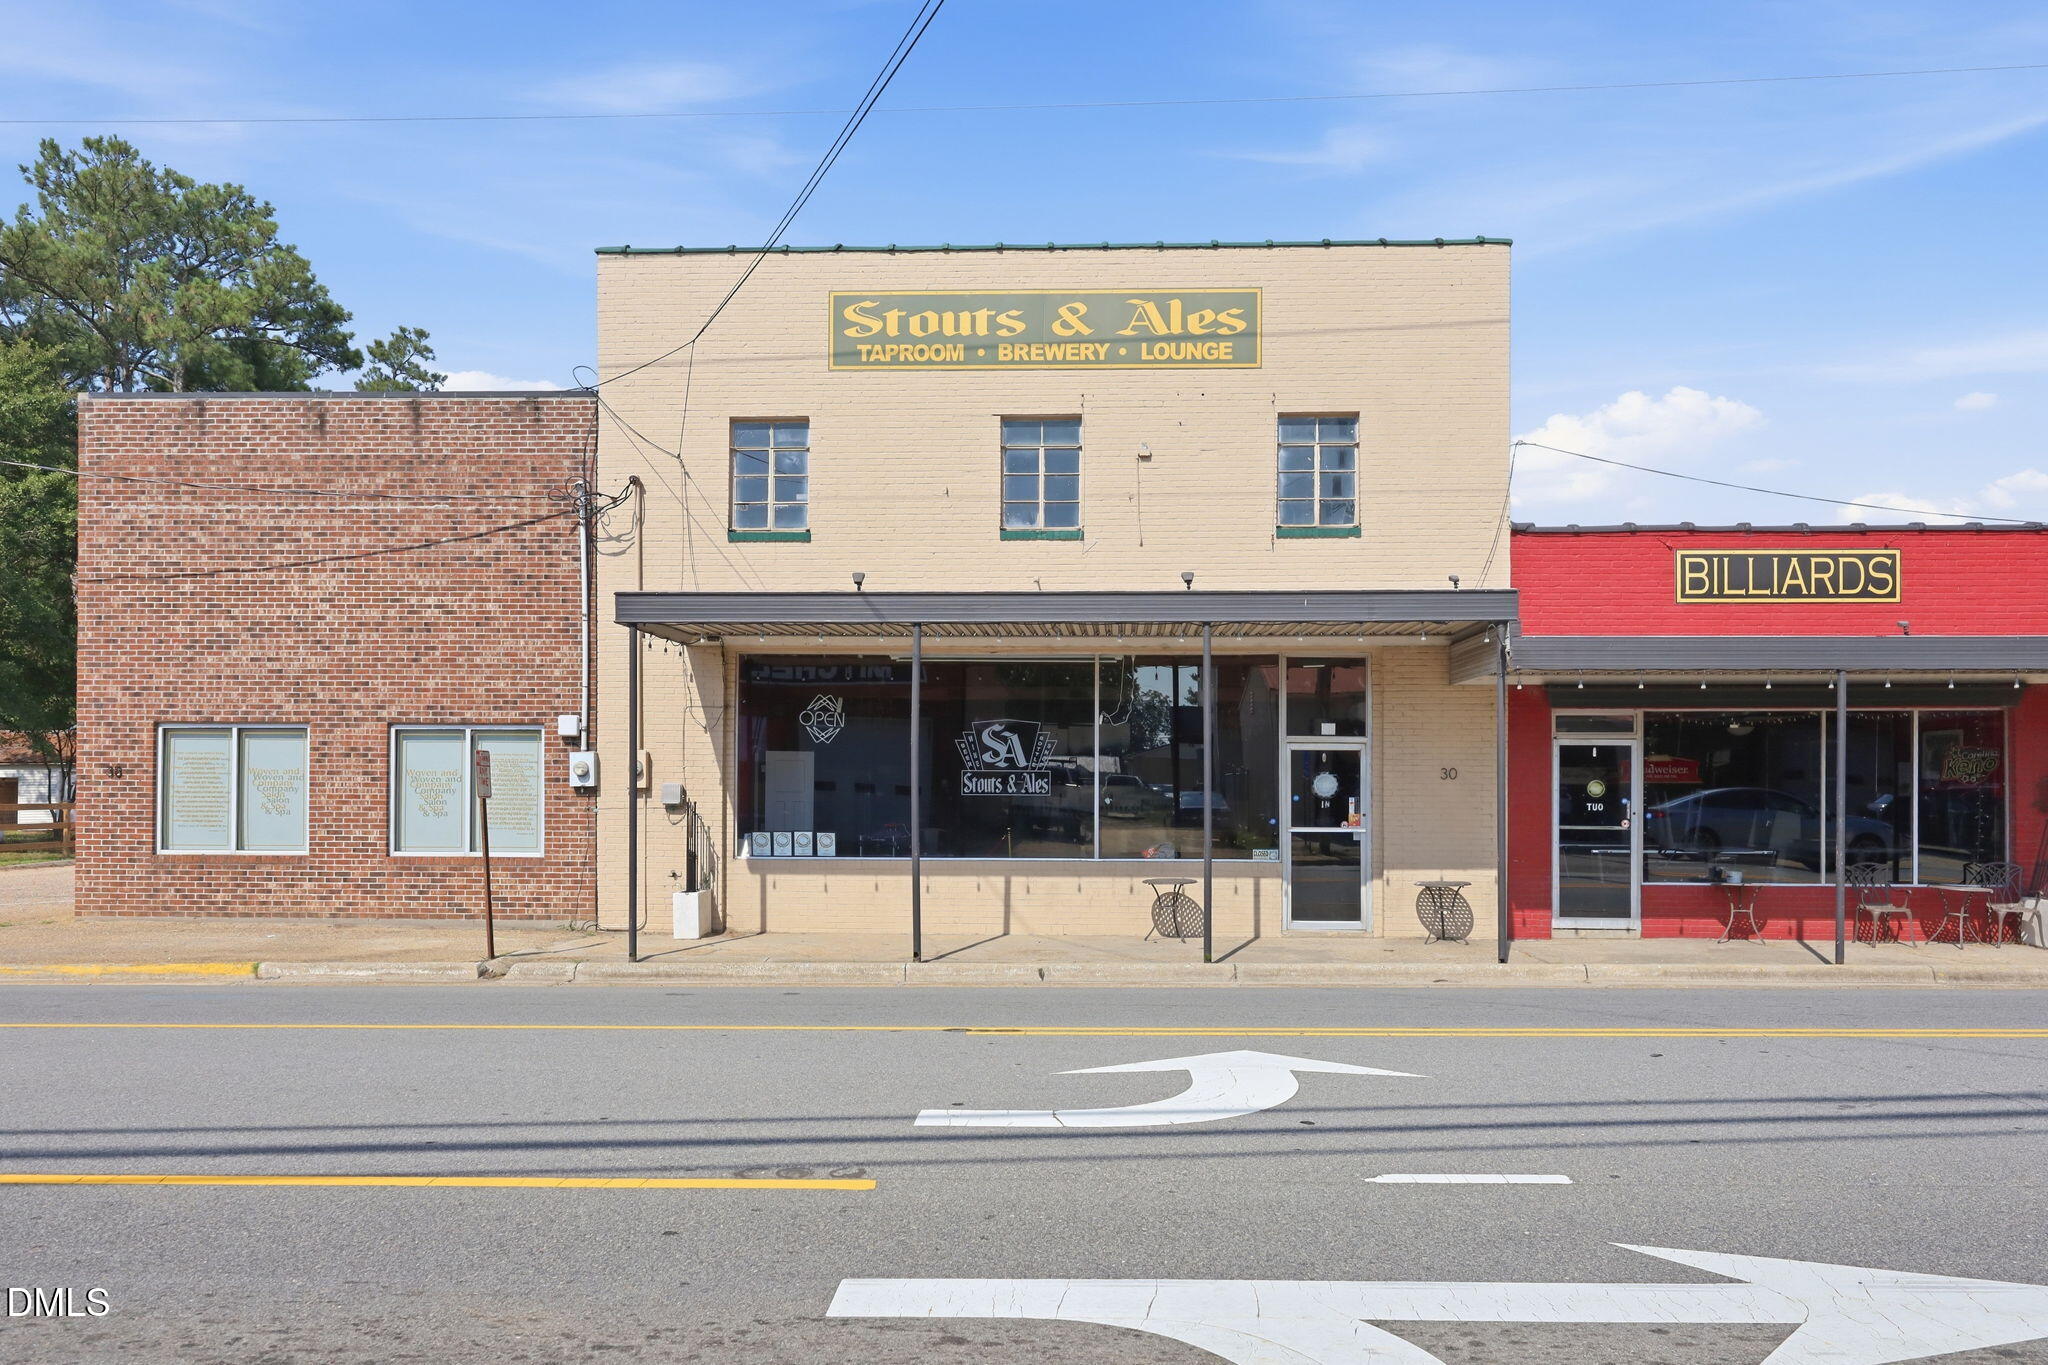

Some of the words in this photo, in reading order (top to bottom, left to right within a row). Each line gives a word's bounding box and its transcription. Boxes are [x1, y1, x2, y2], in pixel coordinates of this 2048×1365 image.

[842, 300, 1027, 338] Stouts
[1051, 301, 1096, 338] &
[1114, 298, 1248, 337] Ales
[857, 343, 965, 363] TAPROOM
[998, 343, 1110, 362] BREWERY
[1140, 341, 1233, 361] LOUNGE
[1684, 556, 1893, 596] BILLIARDS
[799, 711, 845, 728] OPEN
[960, 743, 973, 768] BEER
[968, 735, 981, 767] WINE
[1031, 735, 1044, 767] BOTTLE
[1440, 767, 1458, 780] 30
[1942, 758, 1998, 779] Keno
[963, 772, 1003, 794] Stouts
[1007, 774, 1017, 794] &
[1020, 772, 1049, 794] Ales
